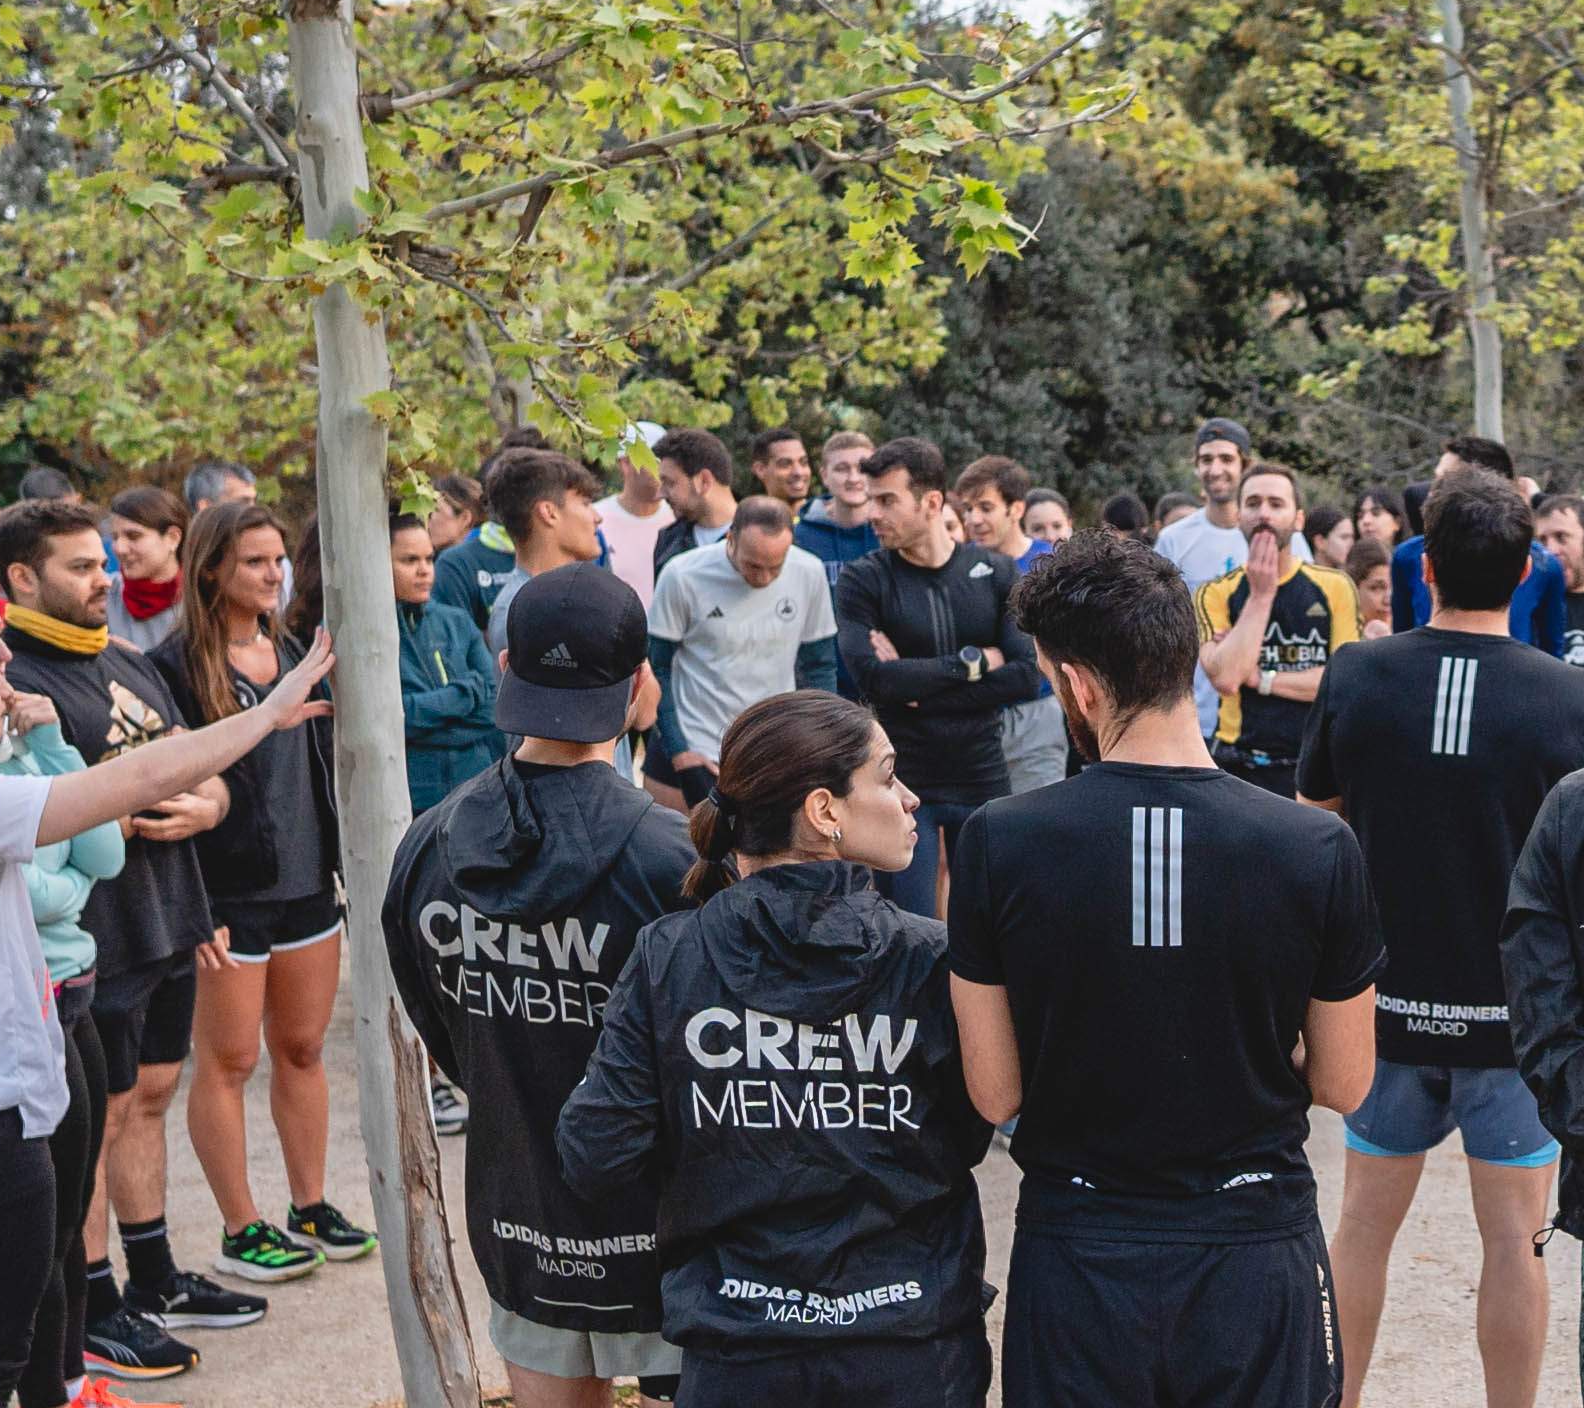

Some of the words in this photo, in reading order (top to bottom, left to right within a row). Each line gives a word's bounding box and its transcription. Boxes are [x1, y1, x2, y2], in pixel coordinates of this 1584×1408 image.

[419, 899, 611, 973] CREW
[1406, 1018, 1468, 1037] MADRID
[1432, 1002, 1510, 1022] RUNNERS
[684, 1007, 919, 1075] CREW
[691, 1080, 921, 1133] MEMBER
[536, 1252, 607, 1280] MADRID
[805, 1280, 924, 1313] RUNNERS
[765, 1302, 858, 1325] MADRID
[1321, 1287, 1335, 1366] TERREX
